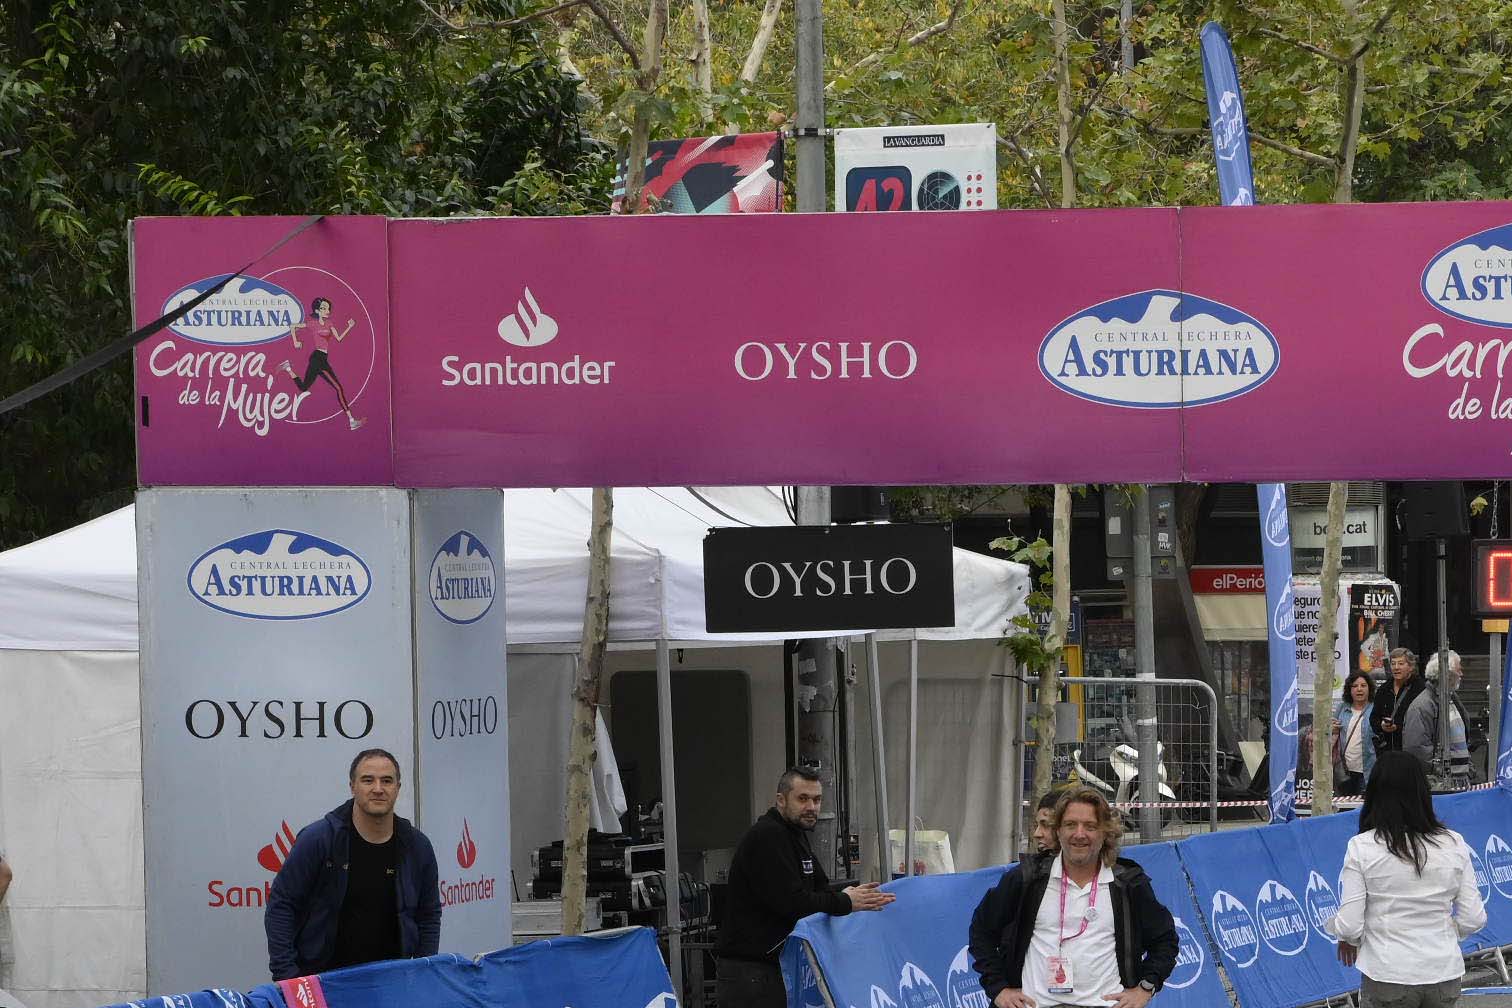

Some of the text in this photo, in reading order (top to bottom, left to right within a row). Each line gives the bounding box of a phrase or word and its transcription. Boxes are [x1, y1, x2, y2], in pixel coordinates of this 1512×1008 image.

[1094, 330, 1254, 344] CENTRAL LECHERA
[149, 340, 267, 378] Carrera
[441, 354, 616, 387] Santander
[733, 339, 918, 381] OYSHO
[1056, 334, 1262, 379] ASTURIANA
[178, 374, 312, 437] de la Mujer
[1448, 381, 1483, 420] de
[201, 562, 359, 599] ASTURIANA
[229, 560, 353, 571] CENTRAL LECHERA
[434, 566, 493, 602] ASTURIANA
[744, 557, 918, 600] OYSHO
[1212, 573, 1265, 589] elPerió
[1363, 593, 1395, 606] ELVIS
[184, 698, 375, 740] OYSHO
[431, 694, 498, 741] OYSHO
